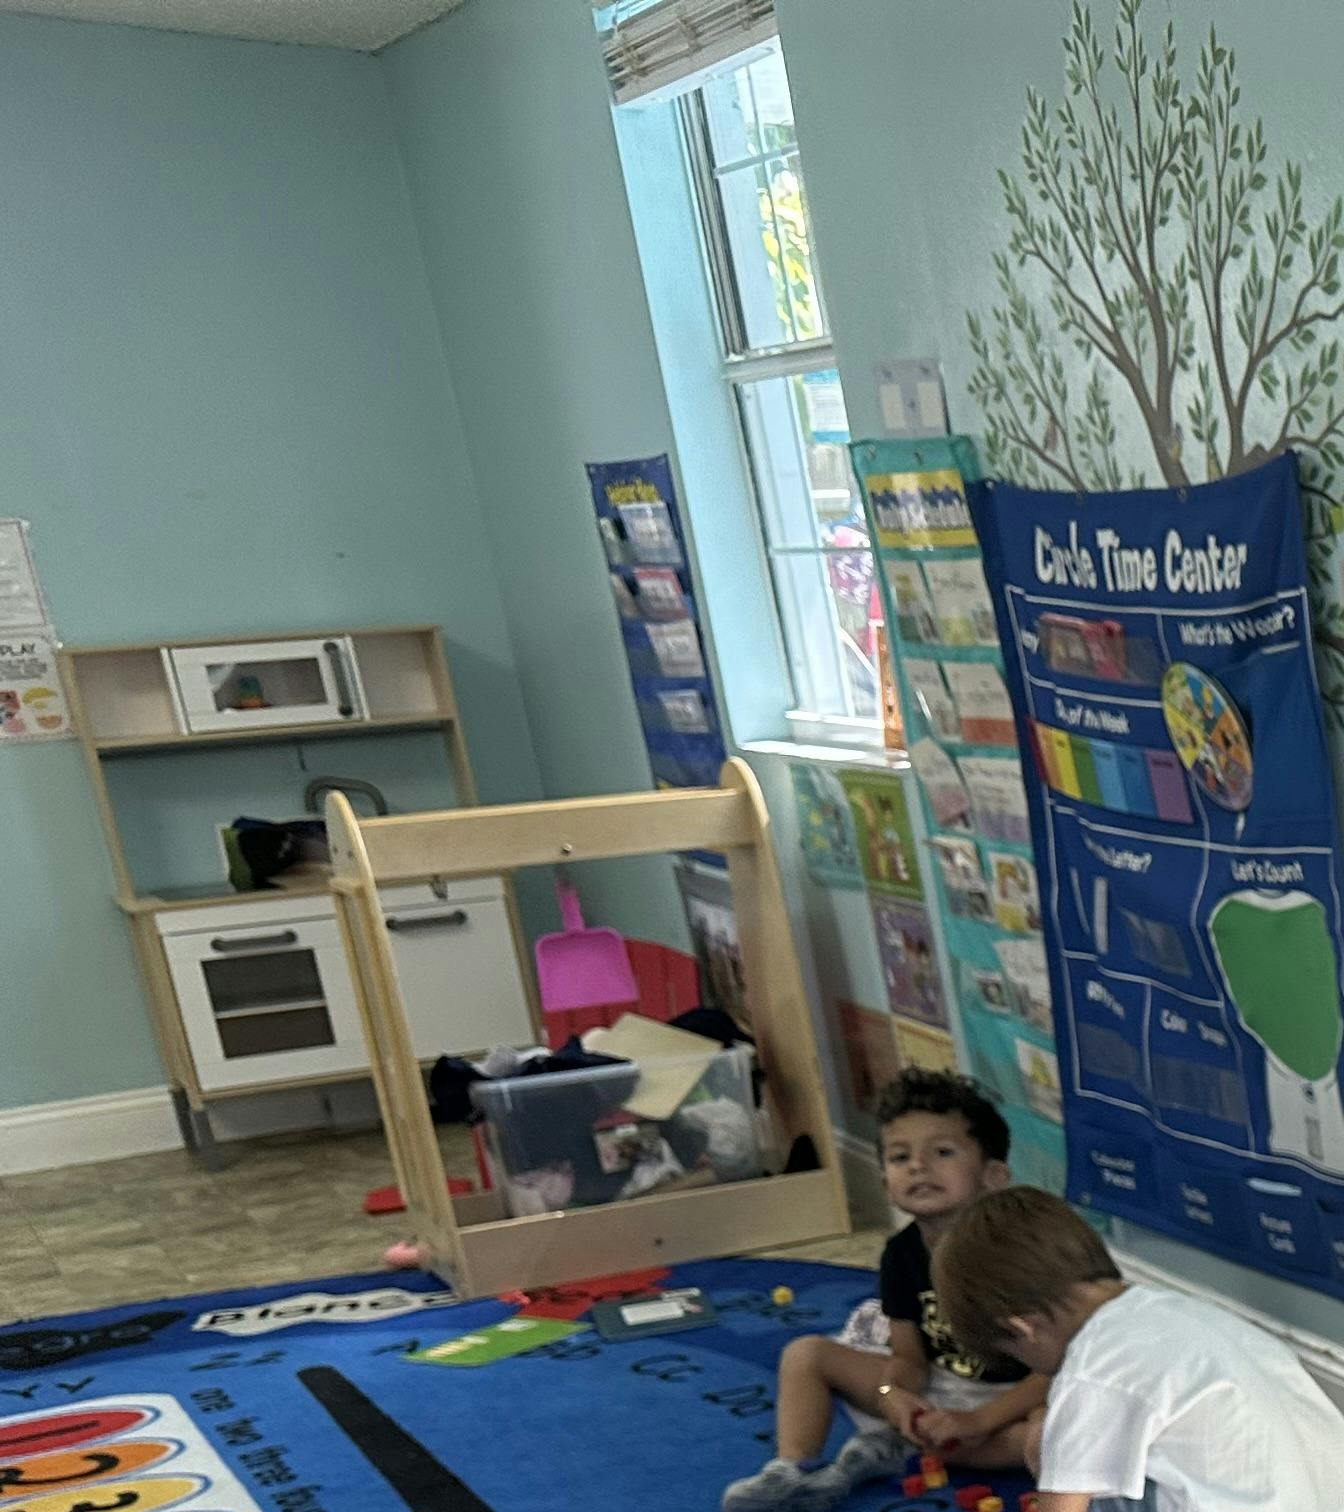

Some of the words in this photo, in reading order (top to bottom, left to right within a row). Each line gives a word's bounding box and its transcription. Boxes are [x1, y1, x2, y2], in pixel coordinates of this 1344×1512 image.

[1034, 520, 1098, 590] Circle
[1095, 528, 1158, 592] Time
[1164, 528, 1247, 594] Center
